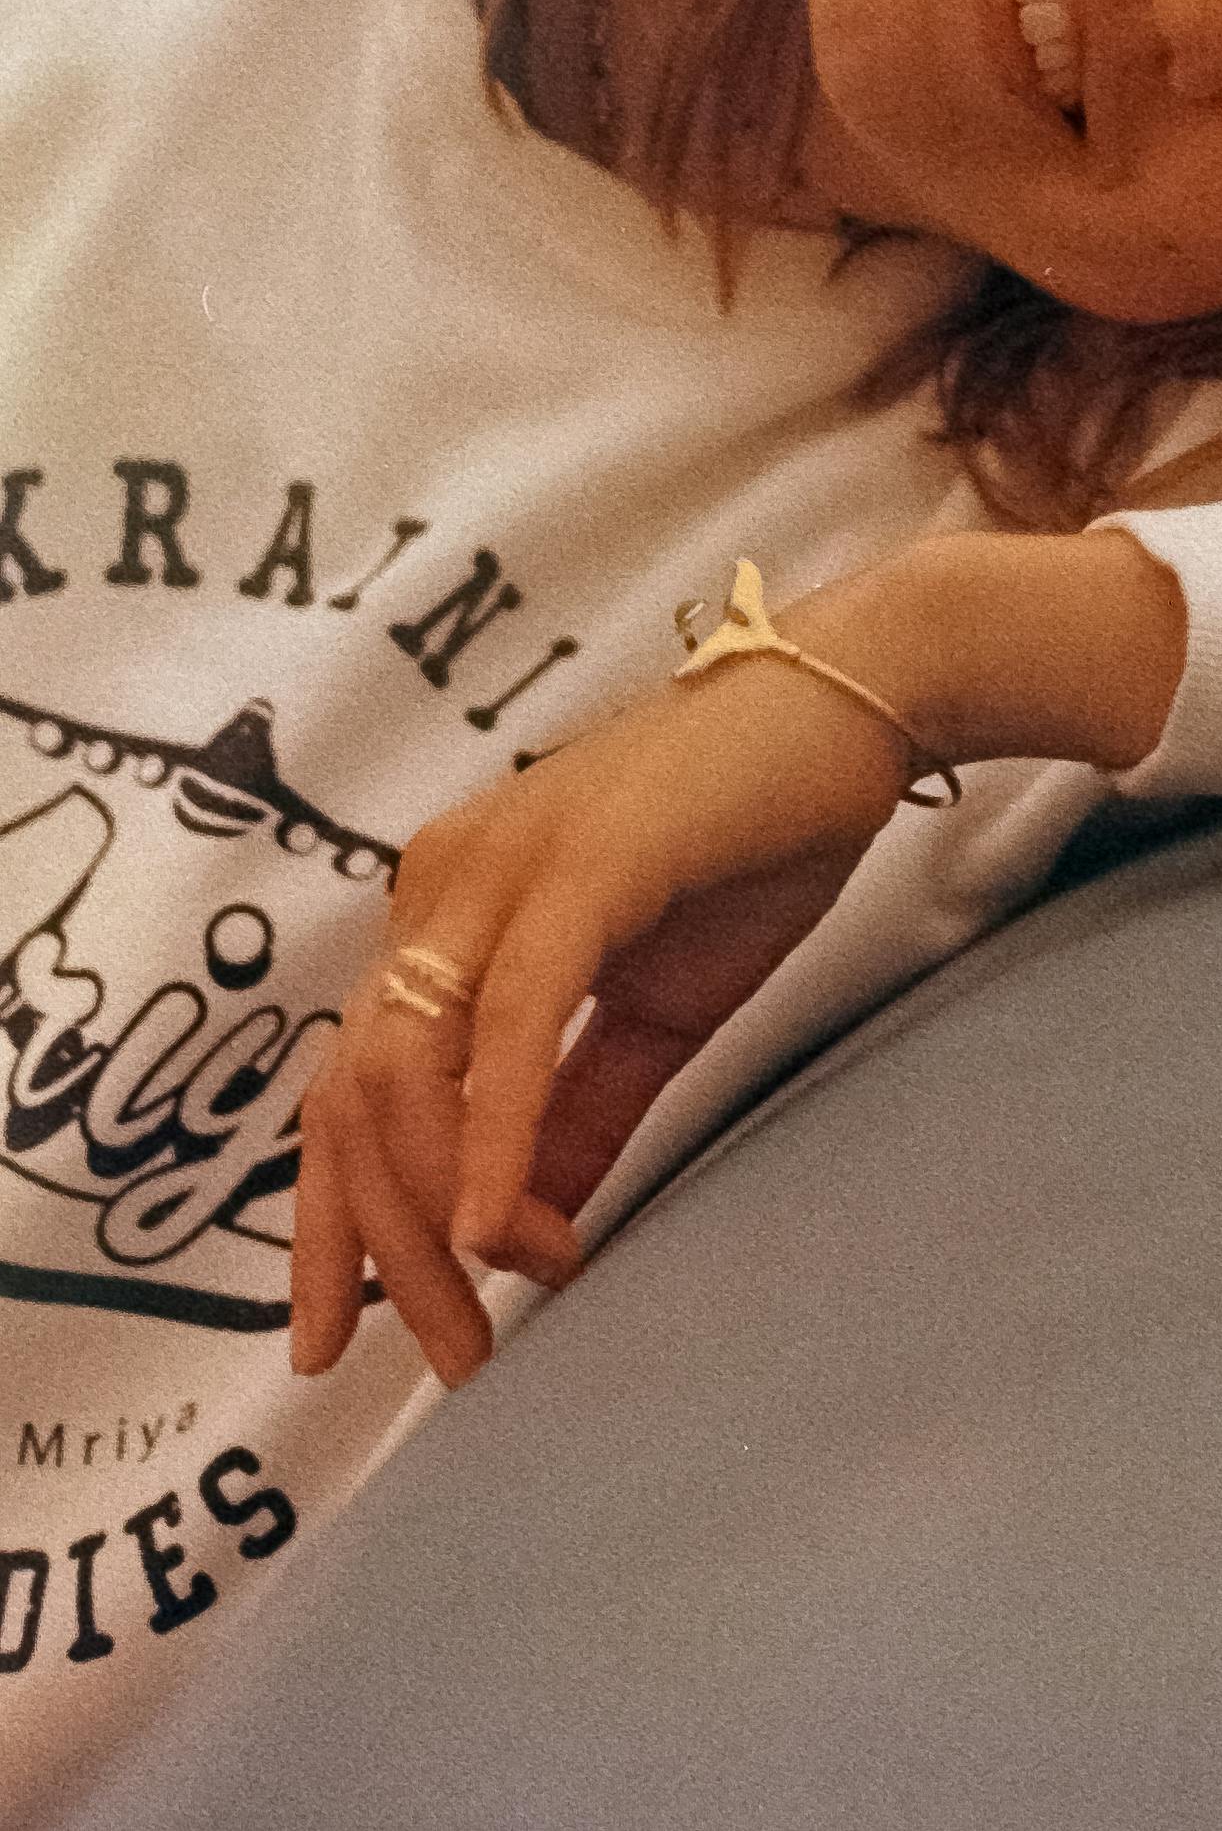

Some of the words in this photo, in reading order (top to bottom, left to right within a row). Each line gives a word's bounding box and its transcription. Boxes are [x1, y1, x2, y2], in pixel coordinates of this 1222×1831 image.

[0, 458, 582, 773] KRAINI
[0, 903, 343, 1265] rig
[0, 1445, 298, 1674] DIES
[17, 1400, 200, 1469] Mriya
